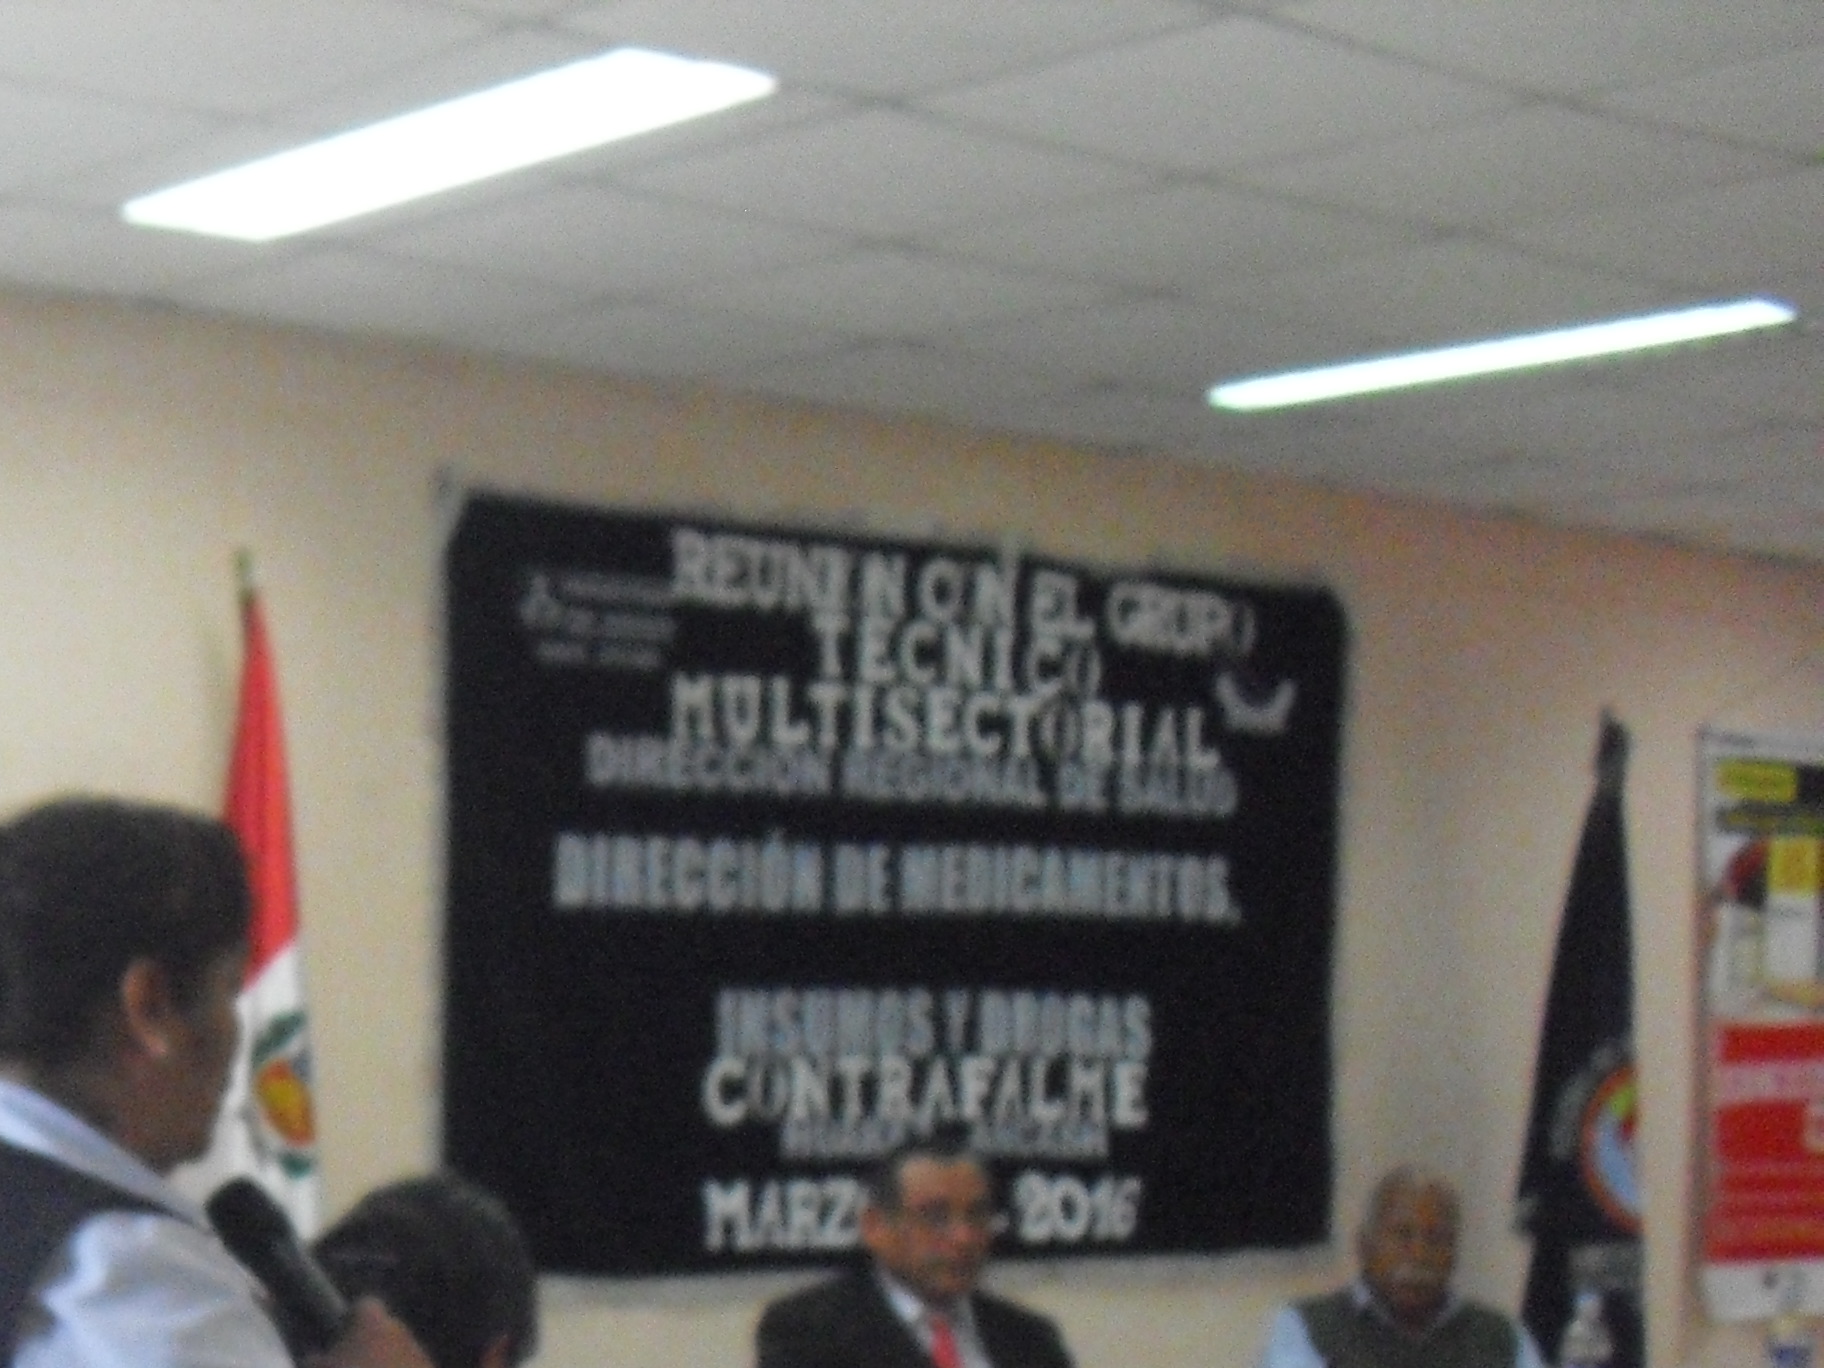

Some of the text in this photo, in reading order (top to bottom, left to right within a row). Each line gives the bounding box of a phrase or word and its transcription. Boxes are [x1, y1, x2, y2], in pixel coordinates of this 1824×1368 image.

[670, 674, 1221, 770] MULTISECTORIAL
[834, 842, 892, 912] DE
[716, 987, 934, 1056] INSUMOS
[943, 987, 972, 1056] Y
